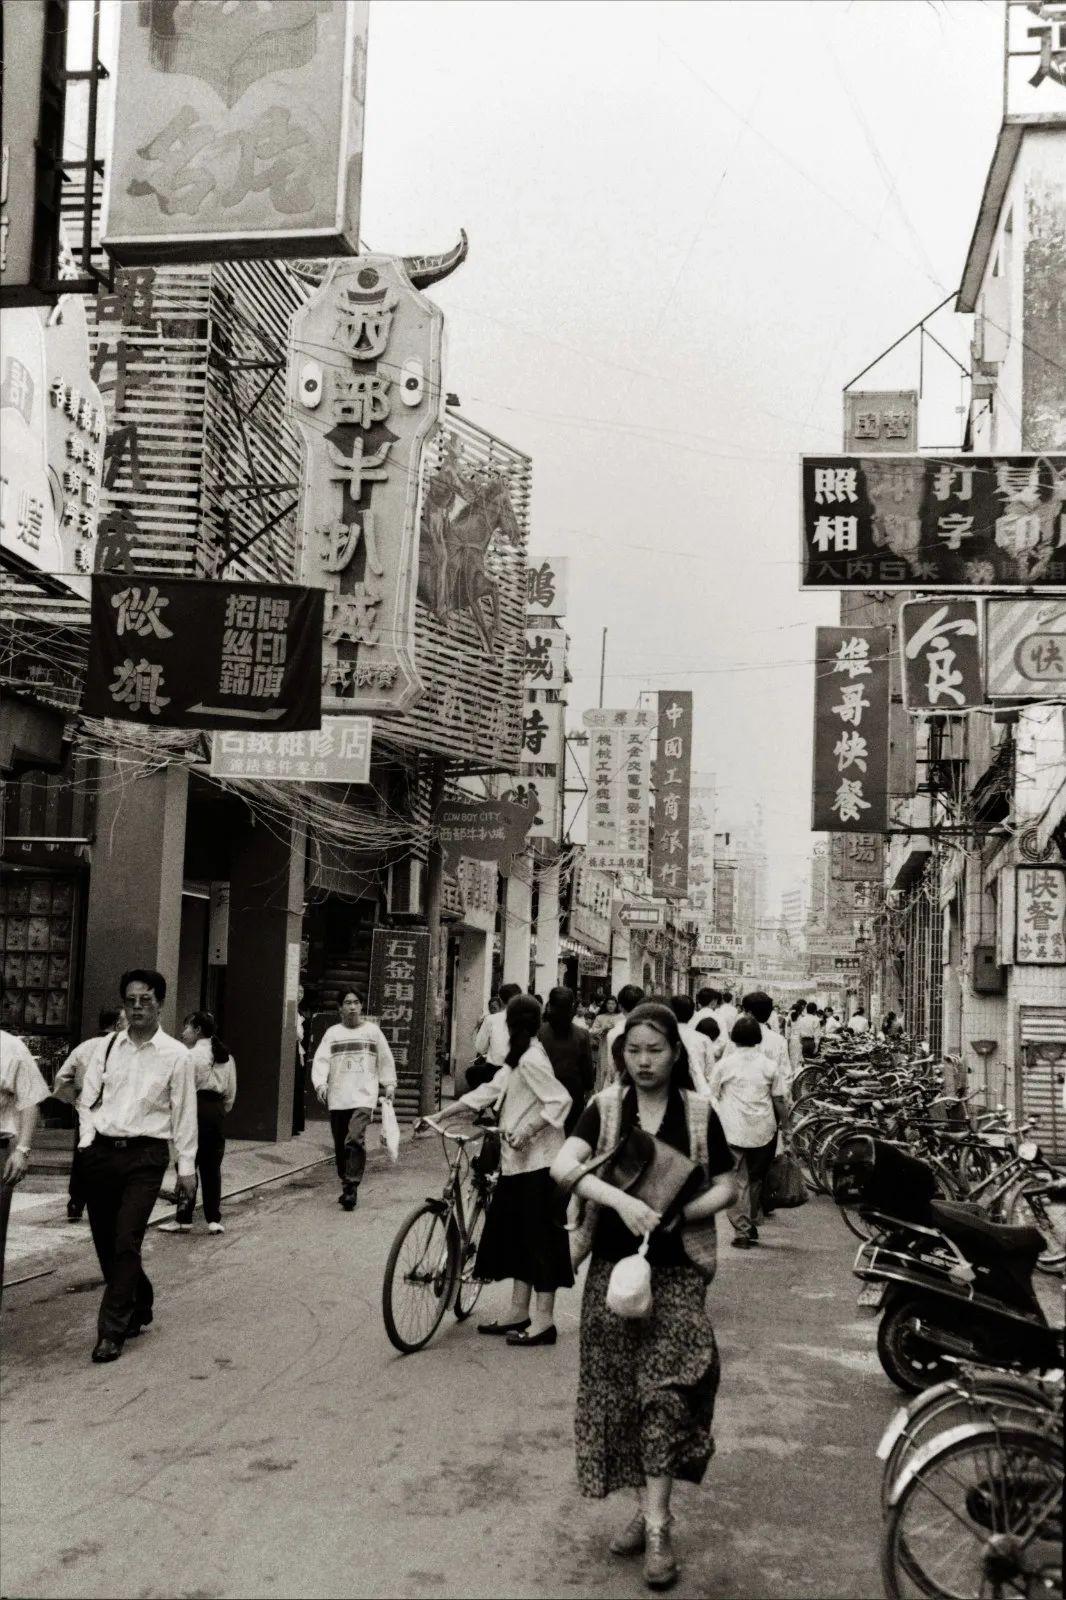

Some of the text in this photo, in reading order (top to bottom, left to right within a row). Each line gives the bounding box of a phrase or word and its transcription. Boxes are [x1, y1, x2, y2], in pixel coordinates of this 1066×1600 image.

[813, 467, 858, 551] 照相
[932, 465, 975, 549] 打字
[108, 586, 174, 715] 做旗
[479, 811, 502, 822] CITY
